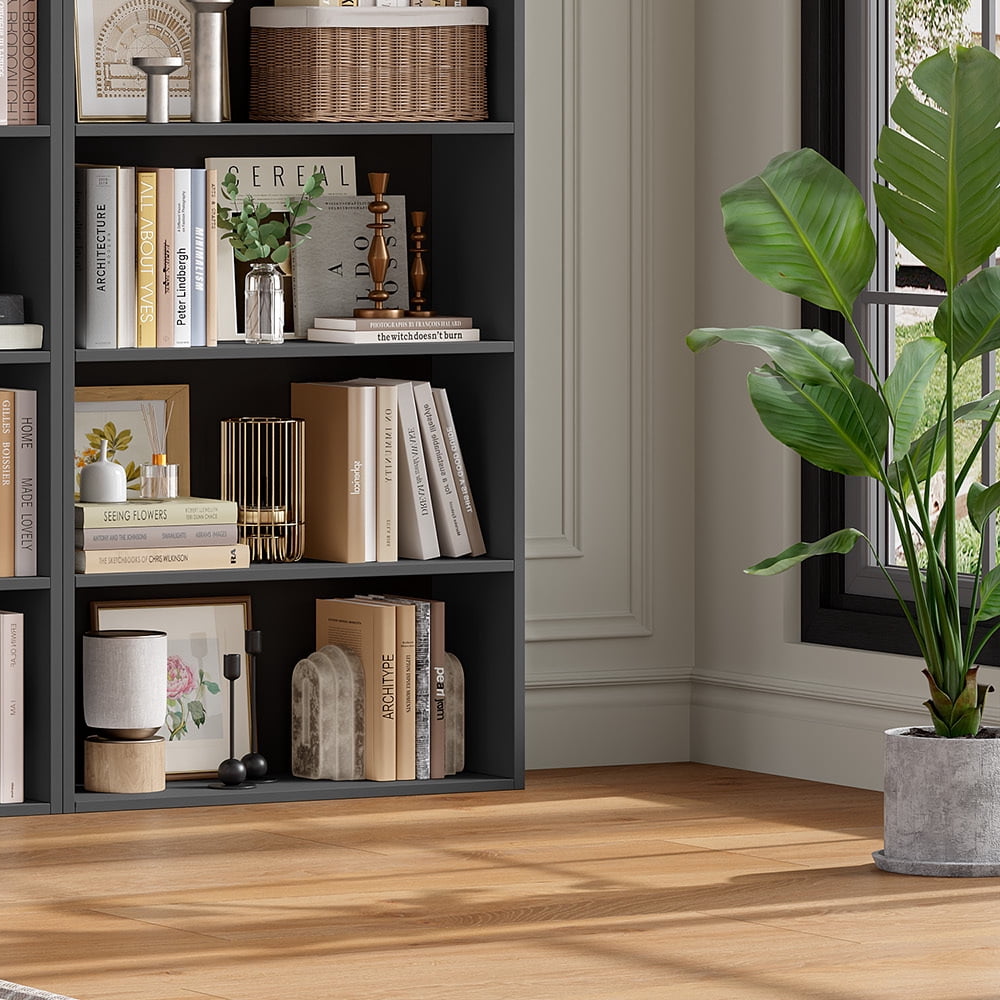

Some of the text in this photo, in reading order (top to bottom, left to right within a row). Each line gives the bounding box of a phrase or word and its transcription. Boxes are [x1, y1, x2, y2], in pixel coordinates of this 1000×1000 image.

[97, 204, 106, 292] ARCHITECTURE
[140, 181, 154, 323] ALL ABOUT YVES
[195, 227, 204, 291] MINIMALISM
[176, 248, 188, 326] Peter Lindbergh
[444, 331, 463, 340] burn
[2, 399, 11, 485] GILLES BOISSIER
[21, 417, 33, 551] HOME MADE LOVELY
[103, 509, 168, 522] SEEING FLOWERS
[148, 555, 163, 564] CHRIS
[163, 554, 190, 563] WILKINSON
[382, 654, 394, 720] ARCHITYPE
[434, 666, 445, 720] pearl jam
